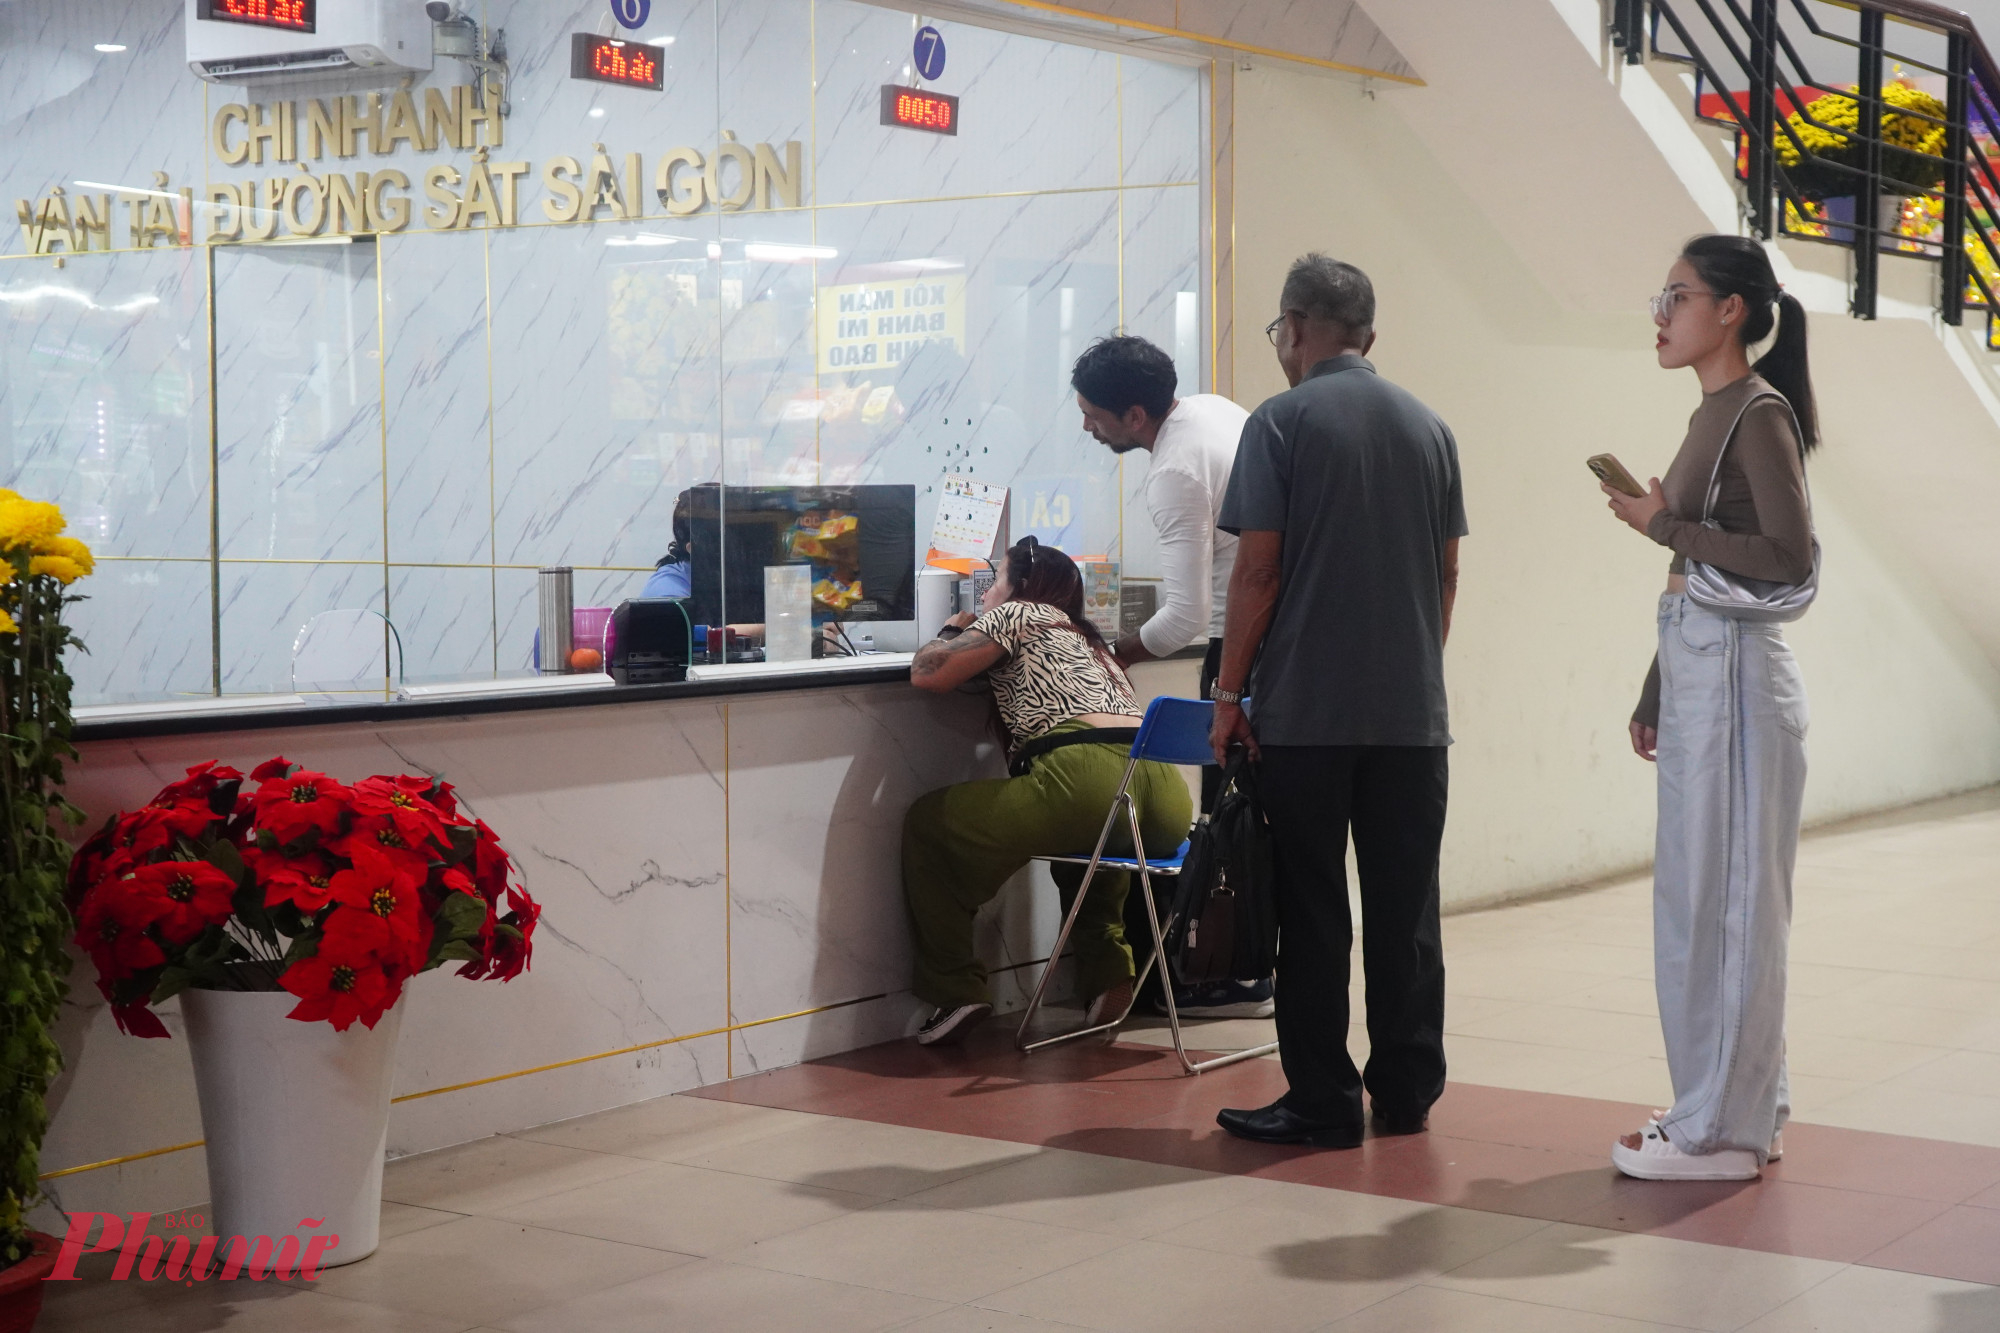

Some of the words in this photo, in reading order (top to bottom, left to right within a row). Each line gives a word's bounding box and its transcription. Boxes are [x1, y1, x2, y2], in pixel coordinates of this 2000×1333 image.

[922, 30, 939, 74] 7
[213, 103, 296, 164] CHI
[307, 75, 502, 154] NHÁNH
[899, 94, 950, 128] 0050
[15, 186, 110, 268] VẬN
[119, 171, 193, 248] TẢI
[203, 162, 410, 241] ĐƯỜNG
[423, 145, 531, 229] SẮT
[542, 142, 642, 222] SÀI
[656, 129, 801, 215] GÒN
